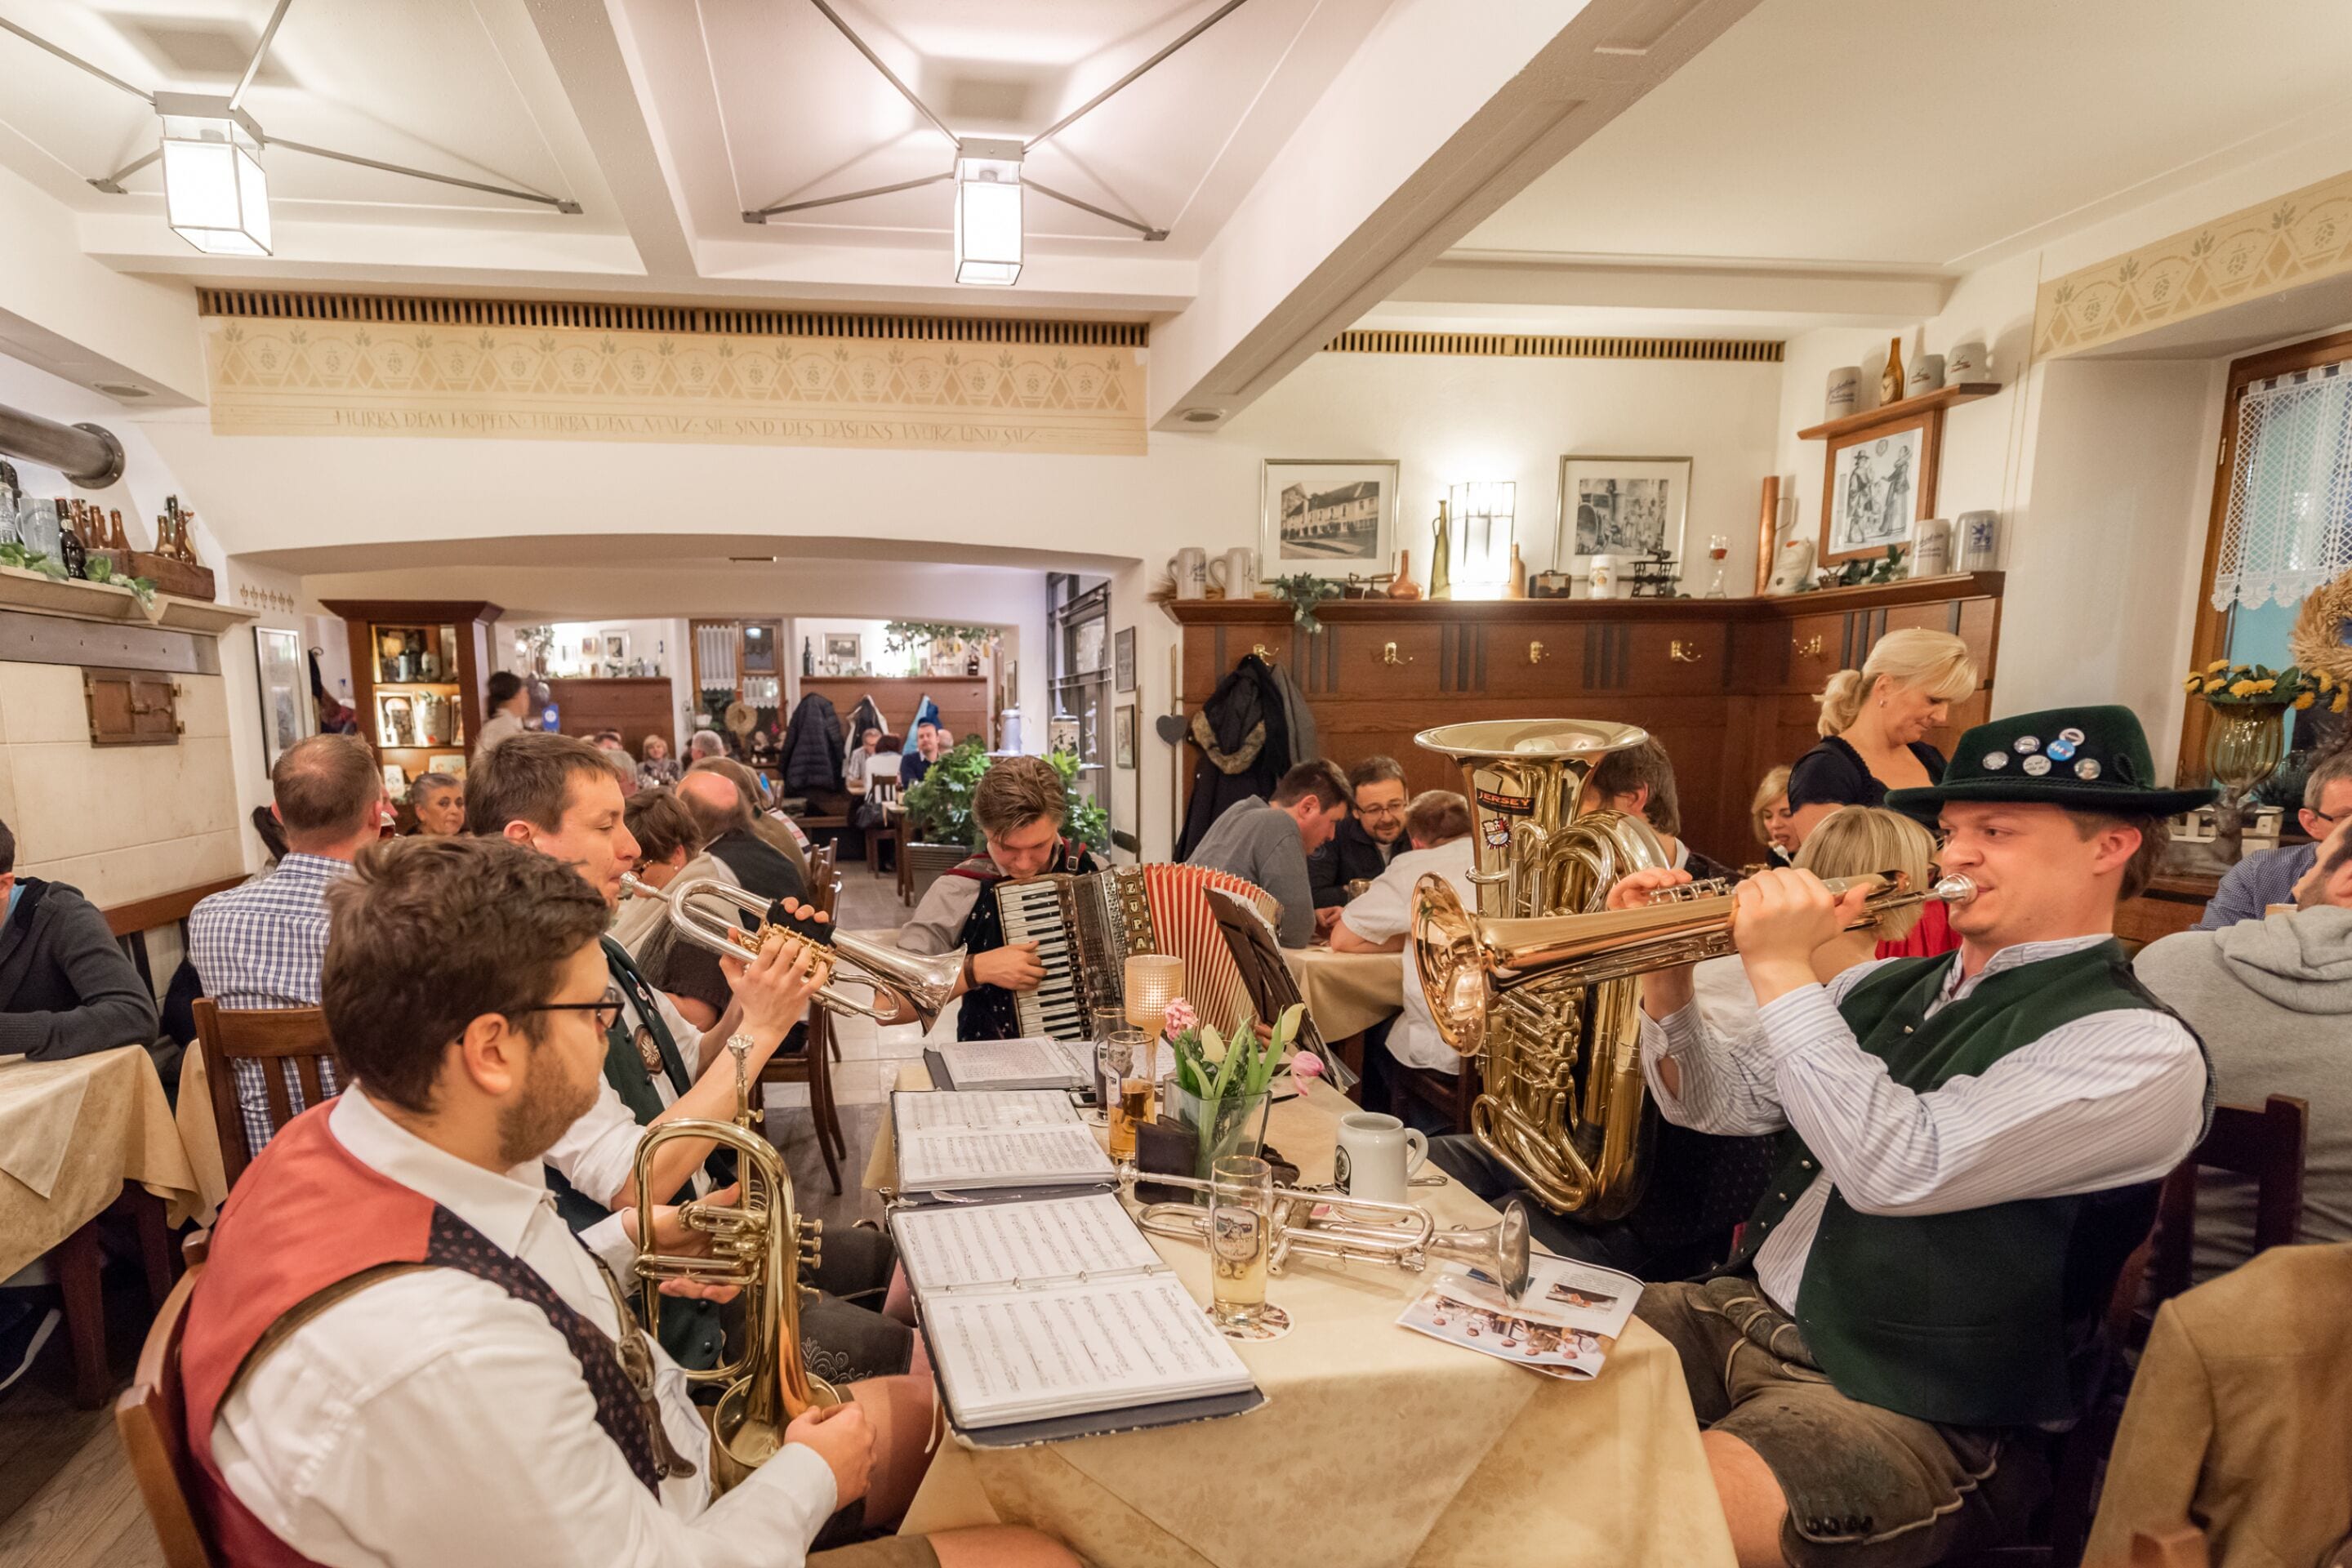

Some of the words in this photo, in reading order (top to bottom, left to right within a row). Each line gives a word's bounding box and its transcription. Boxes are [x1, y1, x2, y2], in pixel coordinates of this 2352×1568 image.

[335, 410, 399, 429] HURRA
[404, 412, 443, 428] DEM
[451, 412, 521, 432] HOPFEN
[532, 414, 591, 433] HURRA
[595, 416, 635, 433] DEM
[640, 416, 693, 434] MALZ
[706, 418, 725, 434] SIE
[734, 418, 775, 436] SIND
[782, 421, 814, 439] DES
[823, 421, 893, 440] DASEINS
[960, 425, 998, 443] UND
[1004, 427, 1036, 447] SALZ
[1478, 791, 1530, 806] JERSEY
